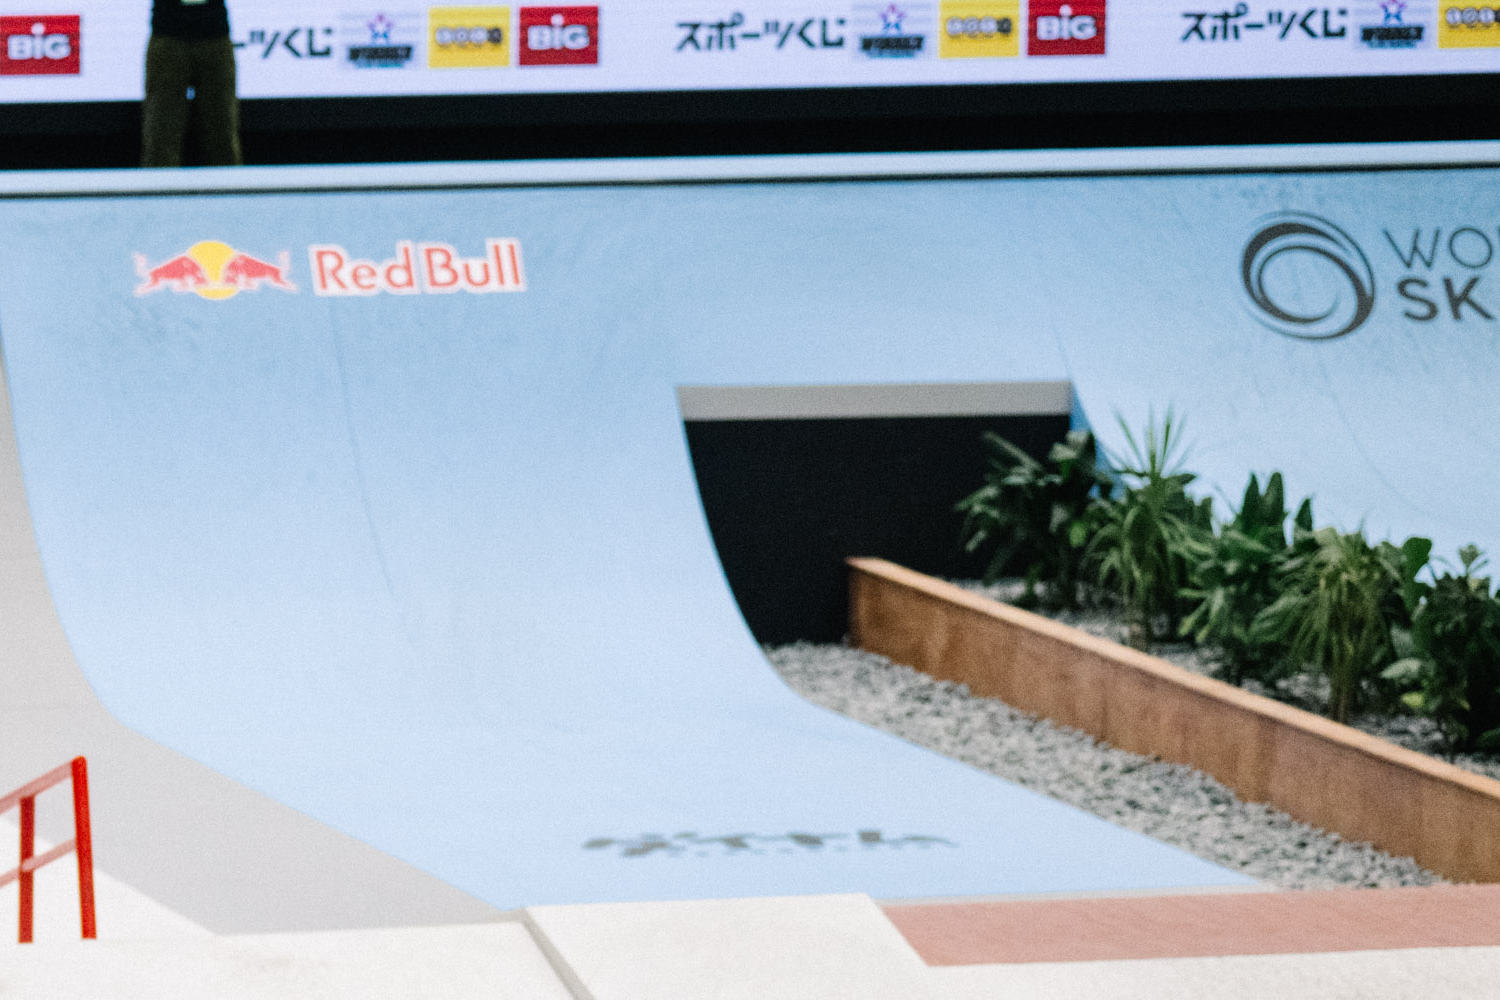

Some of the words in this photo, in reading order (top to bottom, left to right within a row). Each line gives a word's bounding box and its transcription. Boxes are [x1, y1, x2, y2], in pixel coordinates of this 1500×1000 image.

[676, 12, 846, 51] スポーツくじ
[1181, 2, 1347, 42] スポーツくじ
[232, 28, 332, 59] ーツくじ
[313, 243, 416, 291] Red
[422, 241, 522, 289] Bull
[1381, 225, 1500, 270] WO
